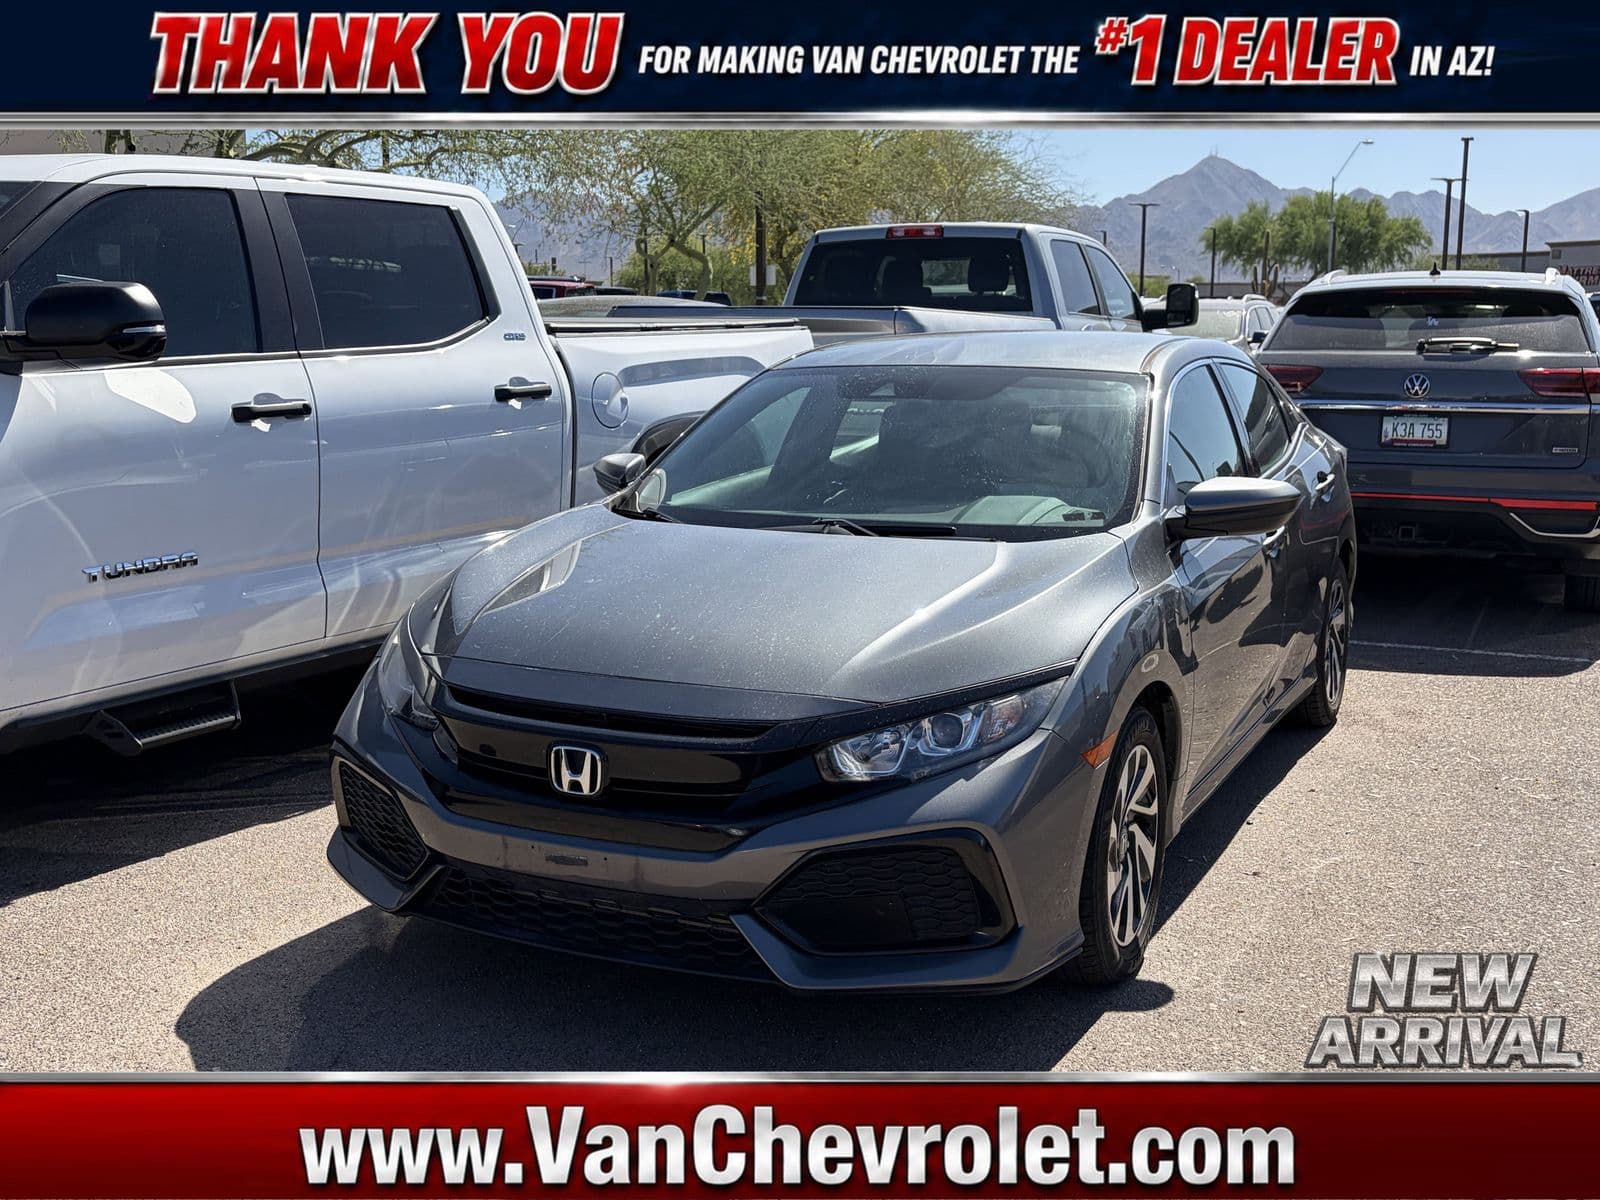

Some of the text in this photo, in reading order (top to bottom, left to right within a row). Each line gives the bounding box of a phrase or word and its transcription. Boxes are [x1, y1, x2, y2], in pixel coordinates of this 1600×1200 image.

[1391, 421, 1443, 439] K3A 755
[82, 551, 199, 583] TUNDRA
